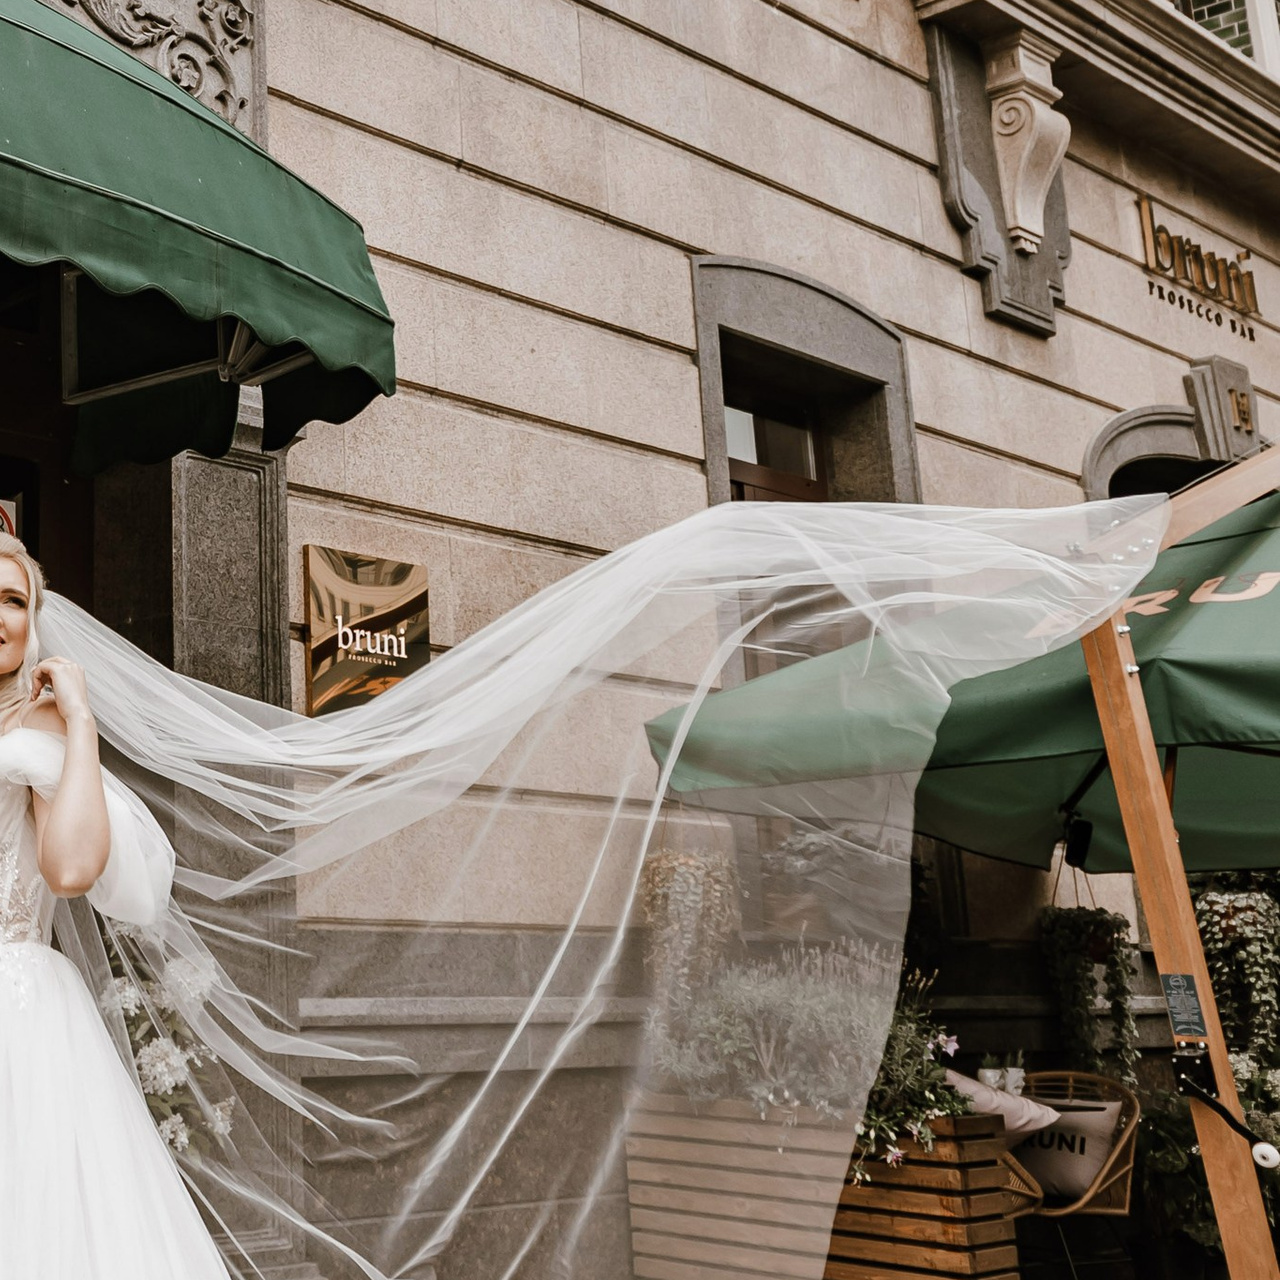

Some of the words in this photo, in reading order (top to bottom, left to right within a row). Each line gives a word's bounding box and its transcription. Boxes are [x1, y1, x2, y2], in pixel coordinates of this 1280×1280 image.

[1134, 193, 1263, 318] bruni
[1148, 280, 1223, 327] PROSECCO
[1229, 318, 1256, 342] BAR
[335, 615, 408, 658] bruni
[348, 654, 382, 665] PROSECCO
